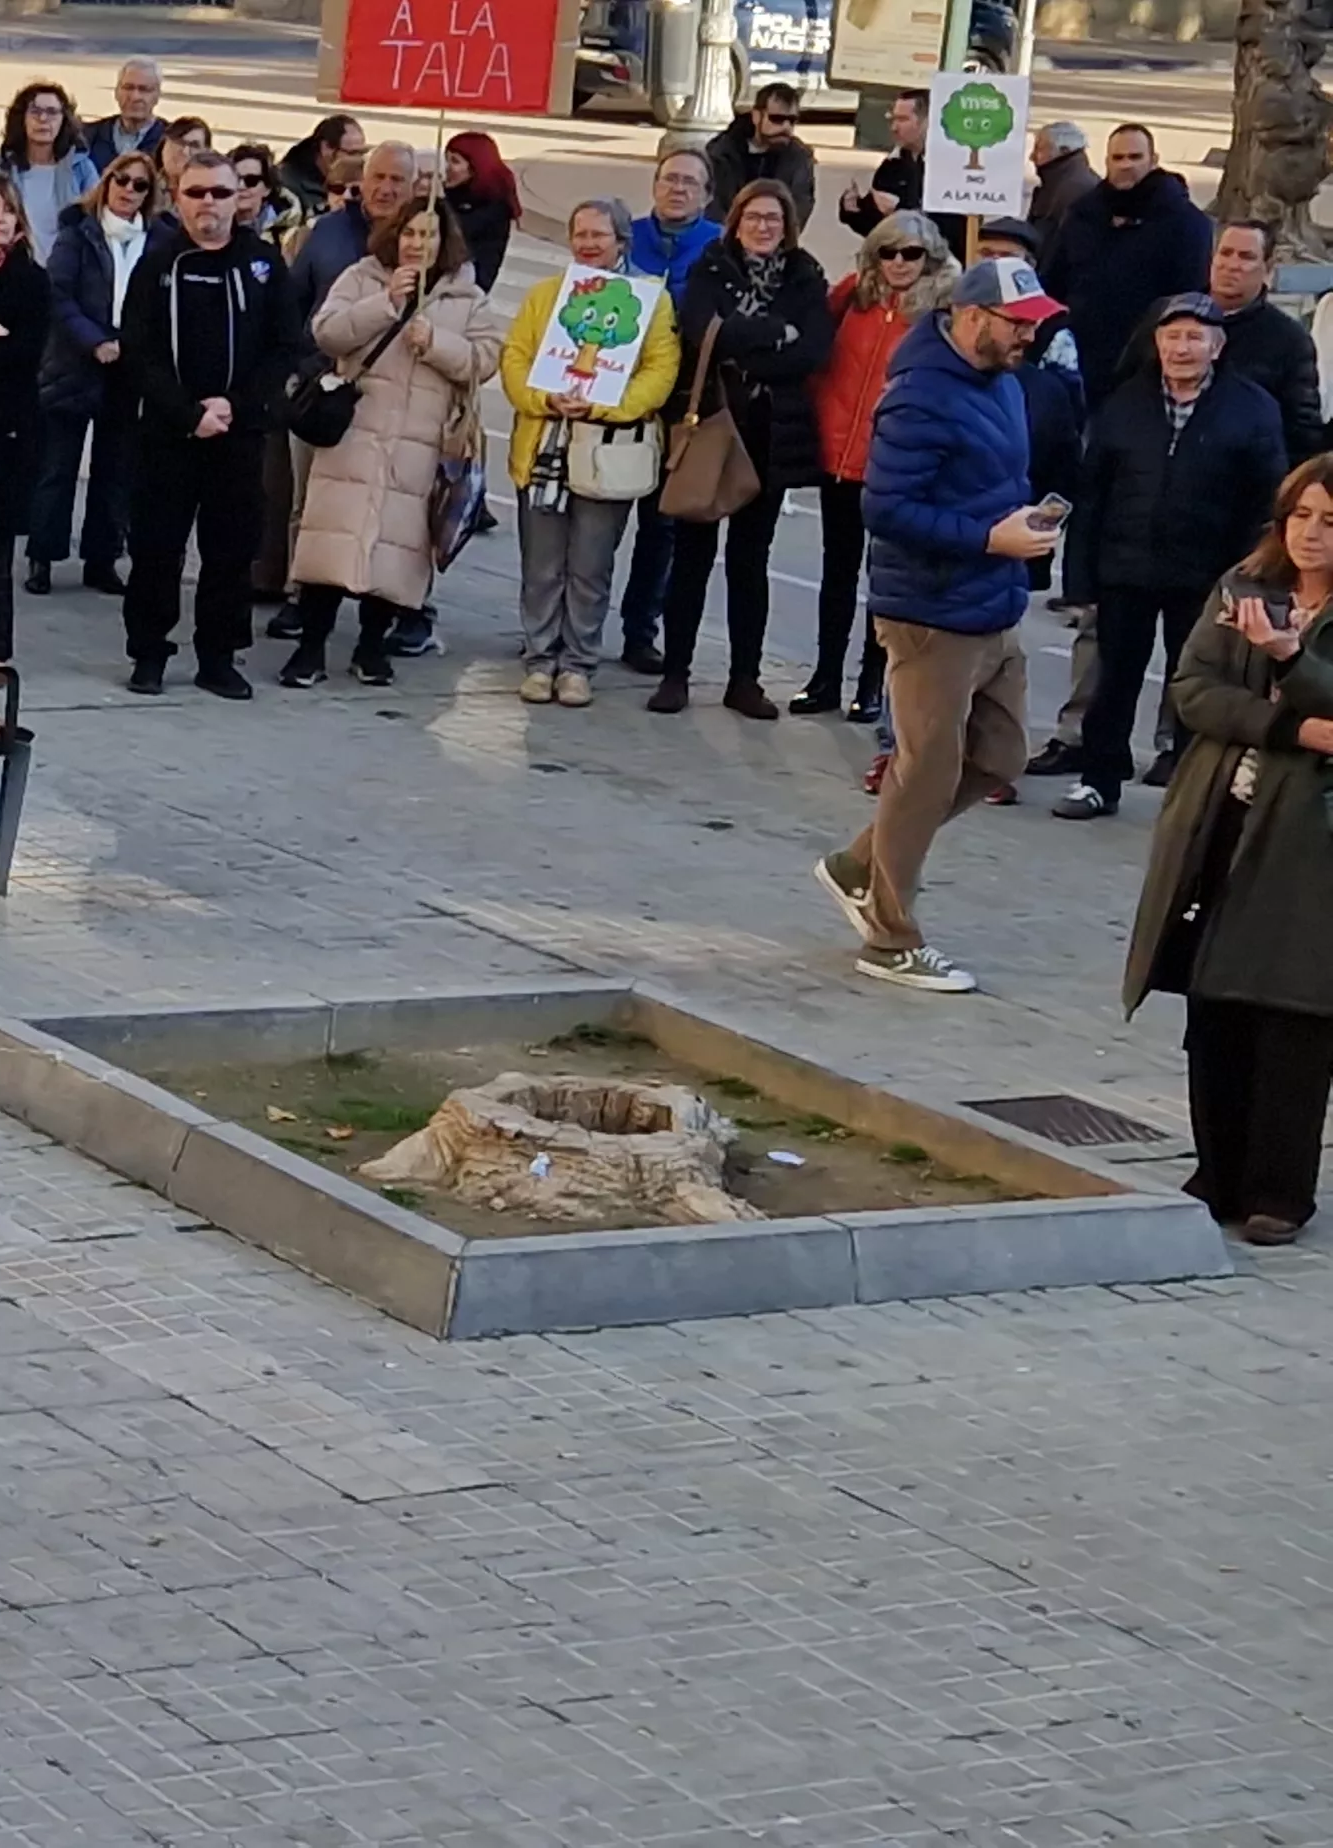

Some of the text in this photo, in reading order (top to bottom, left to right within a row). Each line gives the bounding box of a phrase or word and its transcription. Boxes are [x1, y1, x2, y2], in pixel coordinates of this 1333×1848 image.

[390, 0, 495, 39] A LA
[379, 40, 512, 102] TALA
[965, 174, 986, 185] NO
[942, 189, 1006, 203] A LA TALA
[570, 276, 607, 296] NO
[546, 347, 556, 357] A
[559, 348, 576, 360] LA
